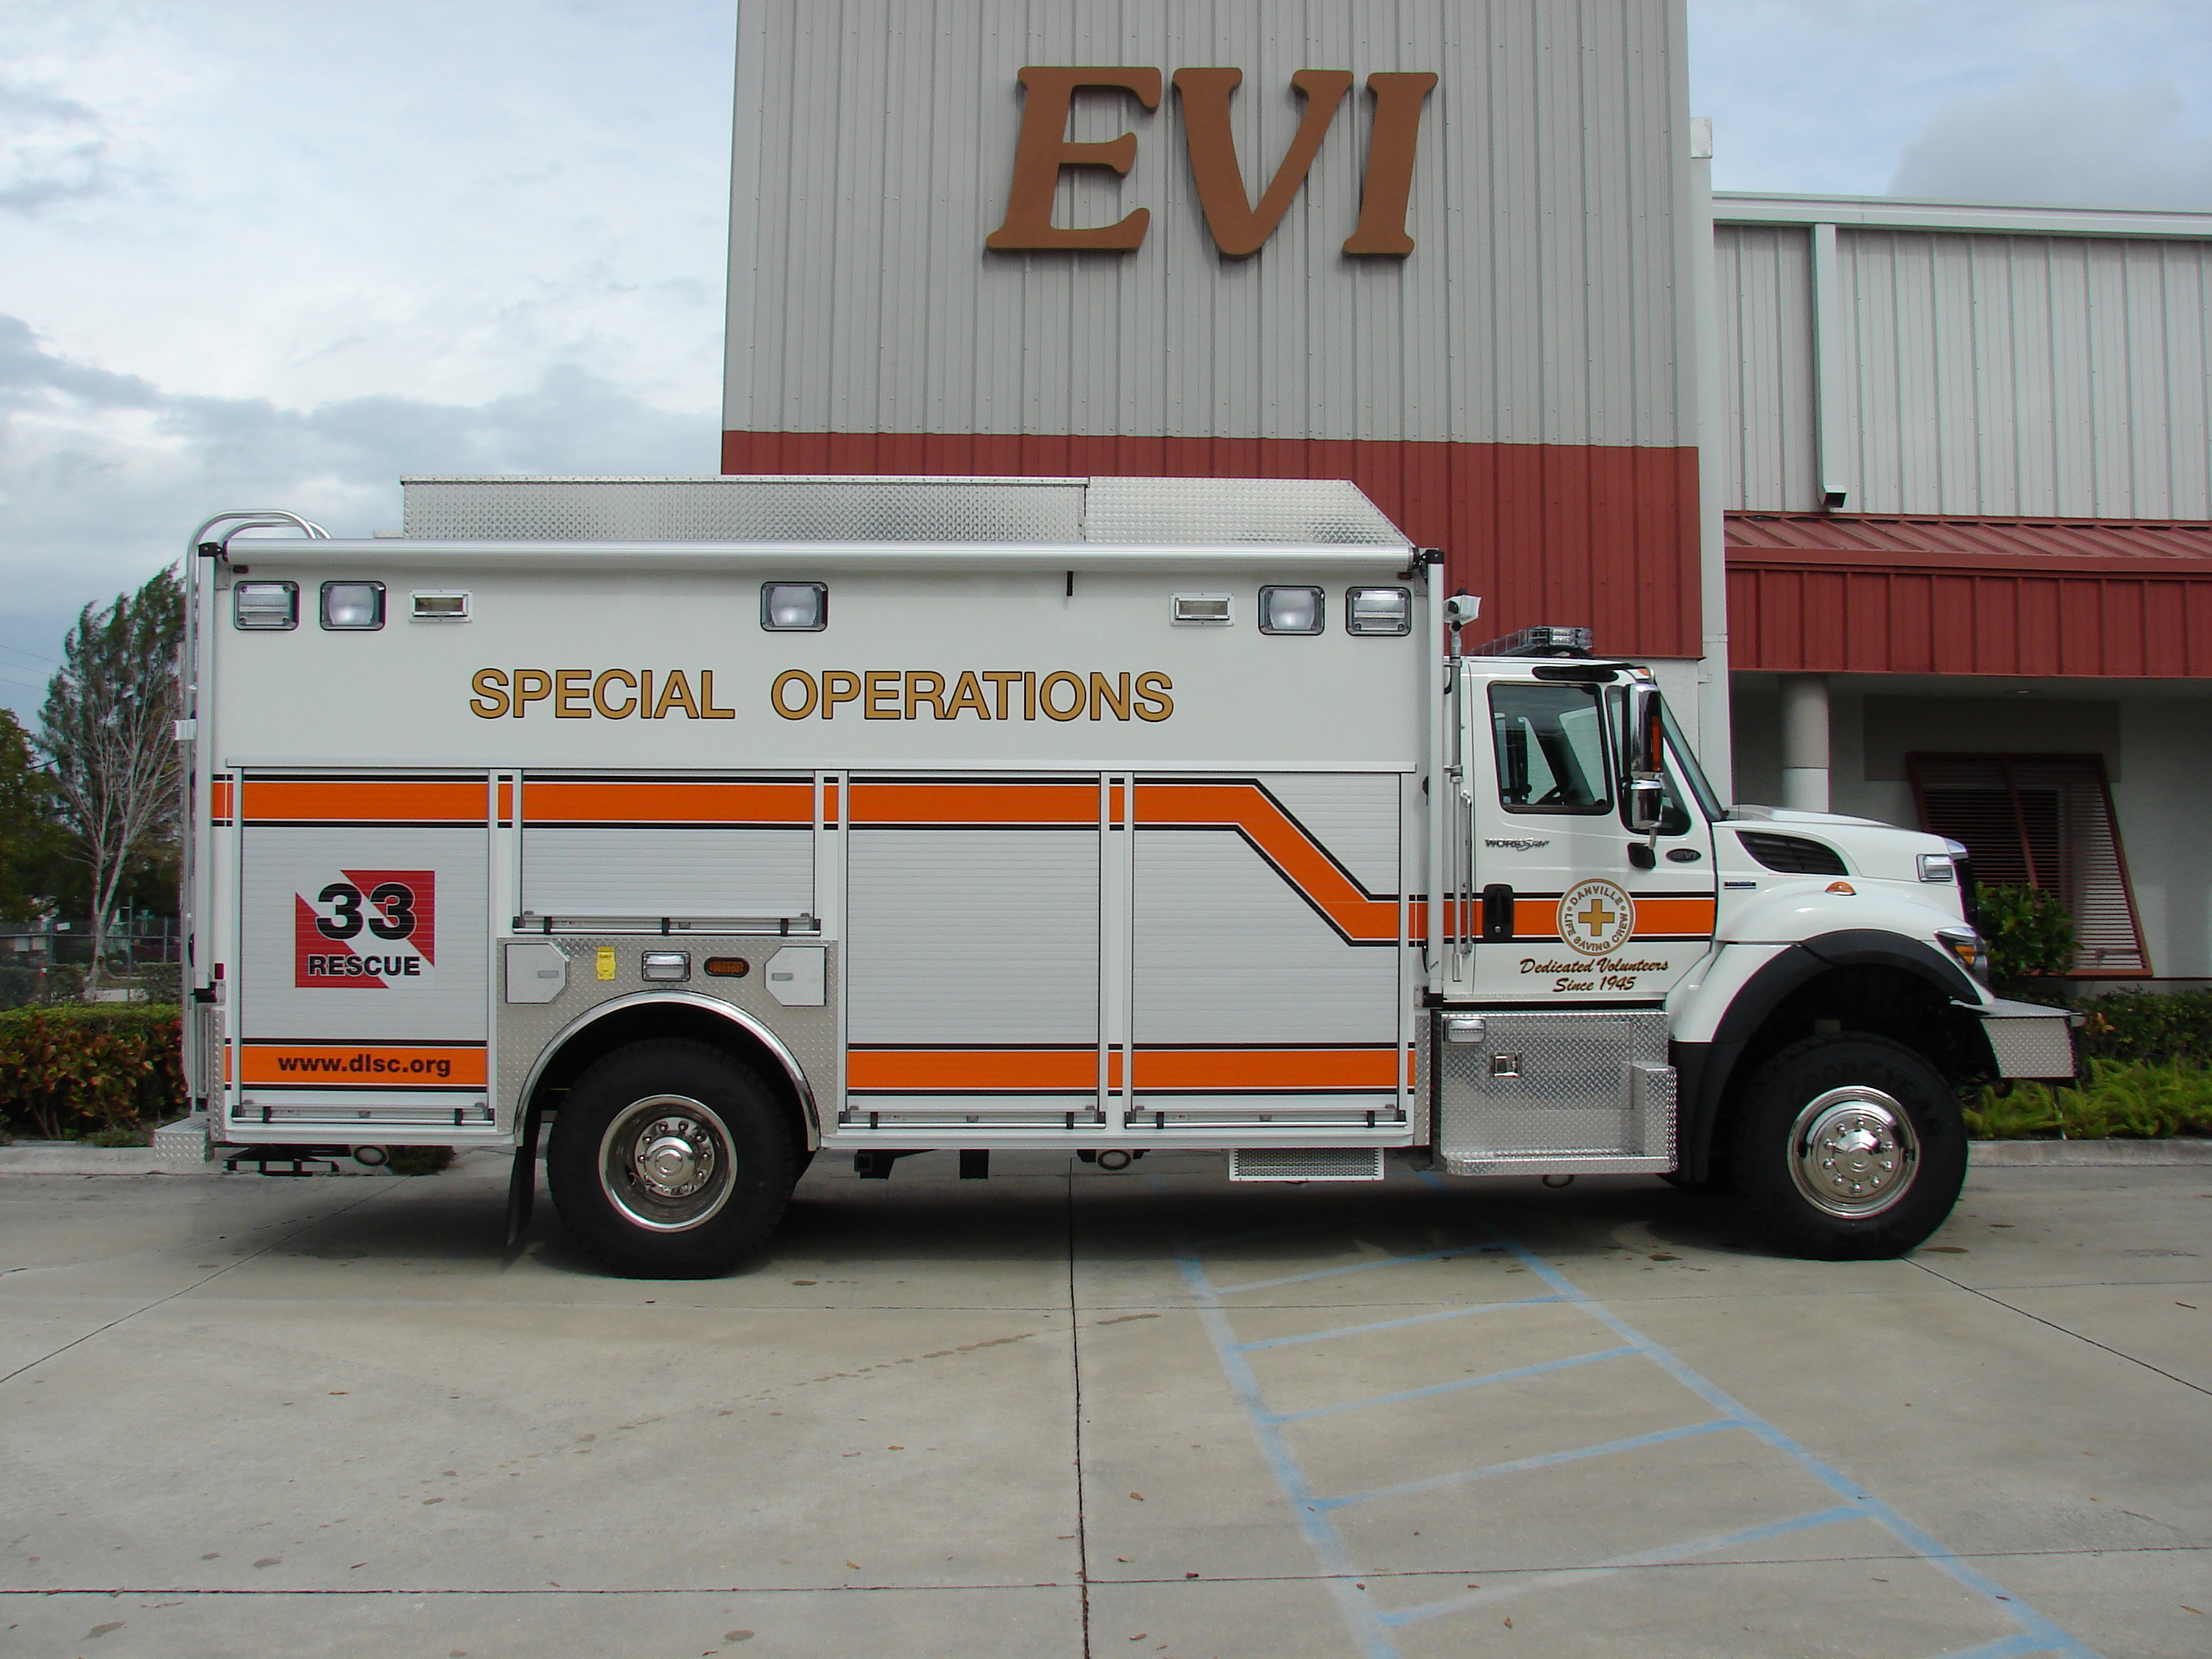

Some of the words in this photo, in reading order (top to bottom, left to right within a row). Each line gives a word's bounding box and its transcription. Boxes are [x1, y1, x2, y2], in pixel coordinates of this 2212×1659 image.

[986, 66, 1438, 258] EVI
[470, 668, 735, 720] SPECIAL
[771, 669, 1174, 722] OPERATIONS
[1569, 885, 1624, 906] DANVILLE
[315, 882, 418, 941] 33
[1565, 913, 1577, 936] LIFE
[1573, 936, 1611, 951] SAVING
[1611, 912, 1628, 943] CREW
[308, 954, 421, 976] RESCUE
[1519, 958, 1595, 973] Dedicated
[1596, 957, 1669, 973] Volunteers
[1552, 977, 1595, 992] Since
[1600, 975, 1638, 991] 1945
[278, 1054, 451, 1078] www.dlsc.org
